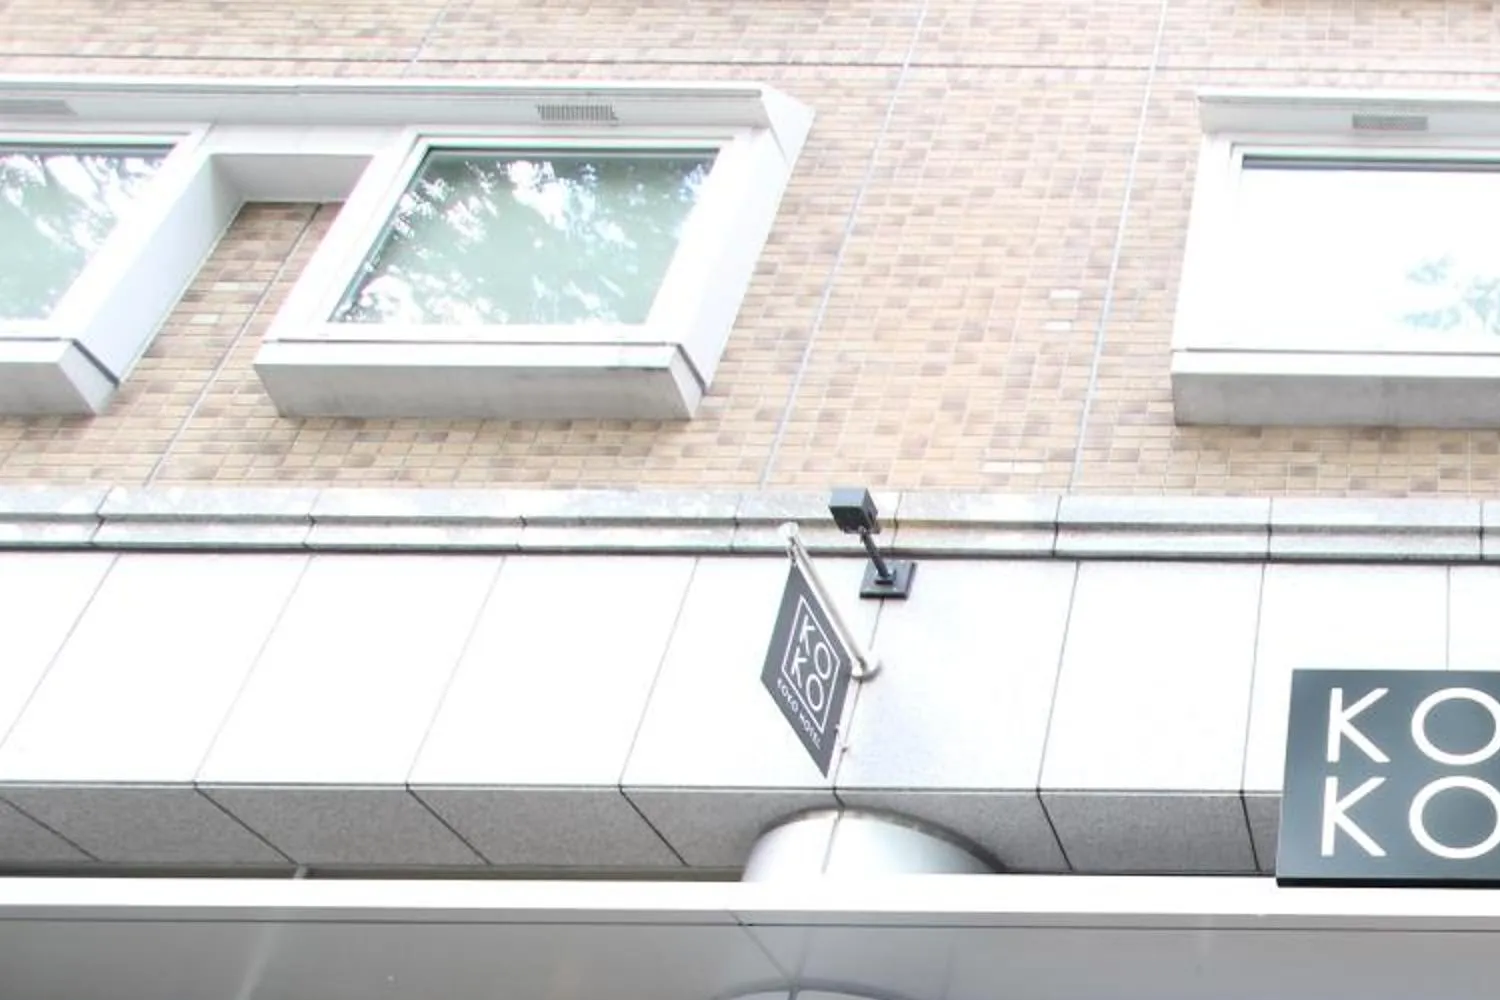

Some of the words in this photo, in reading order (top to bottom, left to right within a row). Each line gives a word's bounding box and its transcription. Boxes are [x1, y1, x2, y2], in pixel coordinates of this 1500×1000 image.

[791, 646, 826, 712] KO
[799, 614, 833, 681] KO
[777, 678, 799, 713] KOKO
[799, 712, 821, 750] HOTEL
